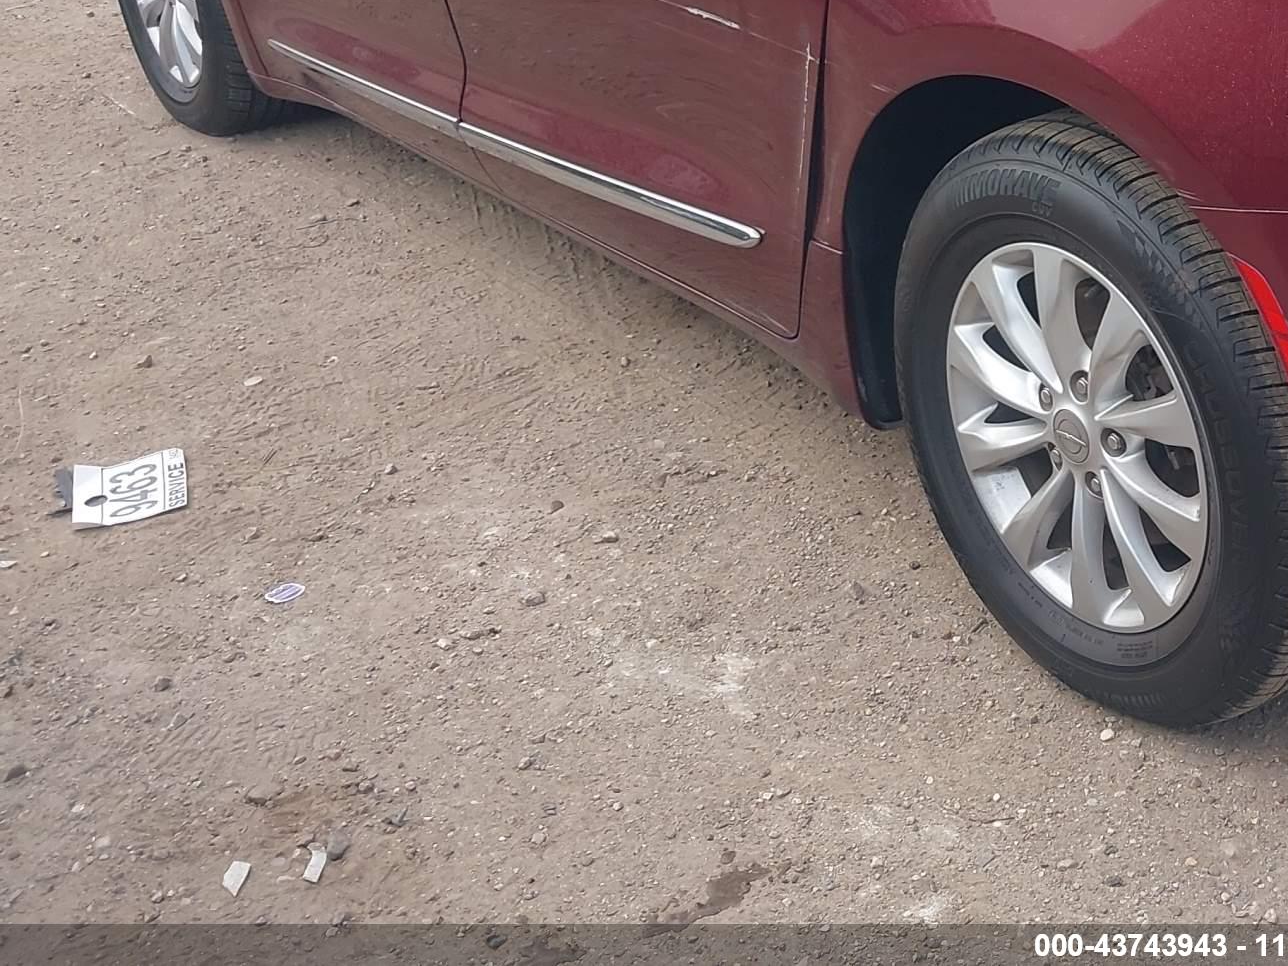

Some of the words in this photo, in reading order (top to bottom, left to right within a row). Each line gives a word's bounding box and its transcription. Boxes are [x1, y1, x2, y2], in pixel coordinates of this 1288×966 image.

[967, 168, 1062, 205] MOHAVE
[108, 463, 158, 518] 9463
[167, 462, 186, 507] SERVICE
